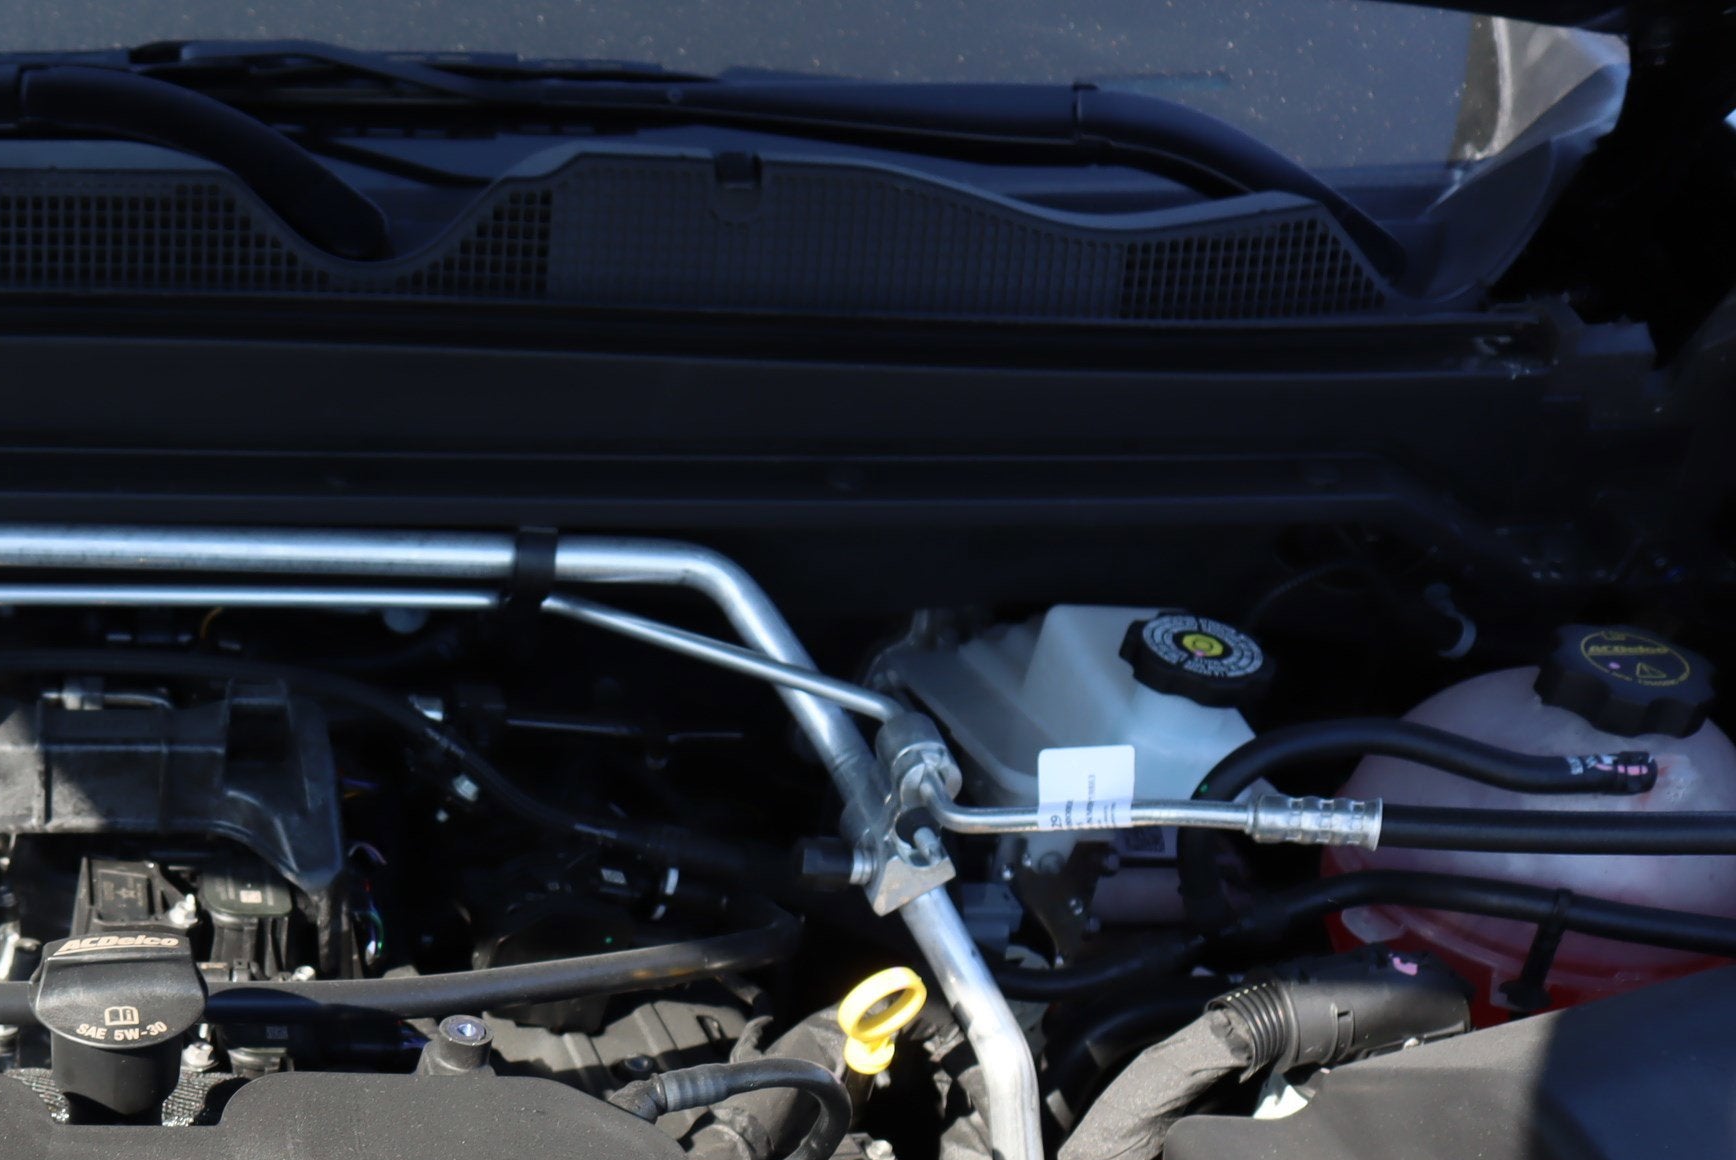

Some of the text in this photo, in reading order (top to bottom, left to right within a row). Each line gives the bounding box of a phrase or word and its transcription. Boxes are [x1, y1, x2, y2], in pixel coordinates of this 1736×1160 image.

[56, 934, 180, 954] ACDelco
[76, 1021, 168, 1041] SAE 5W-30
